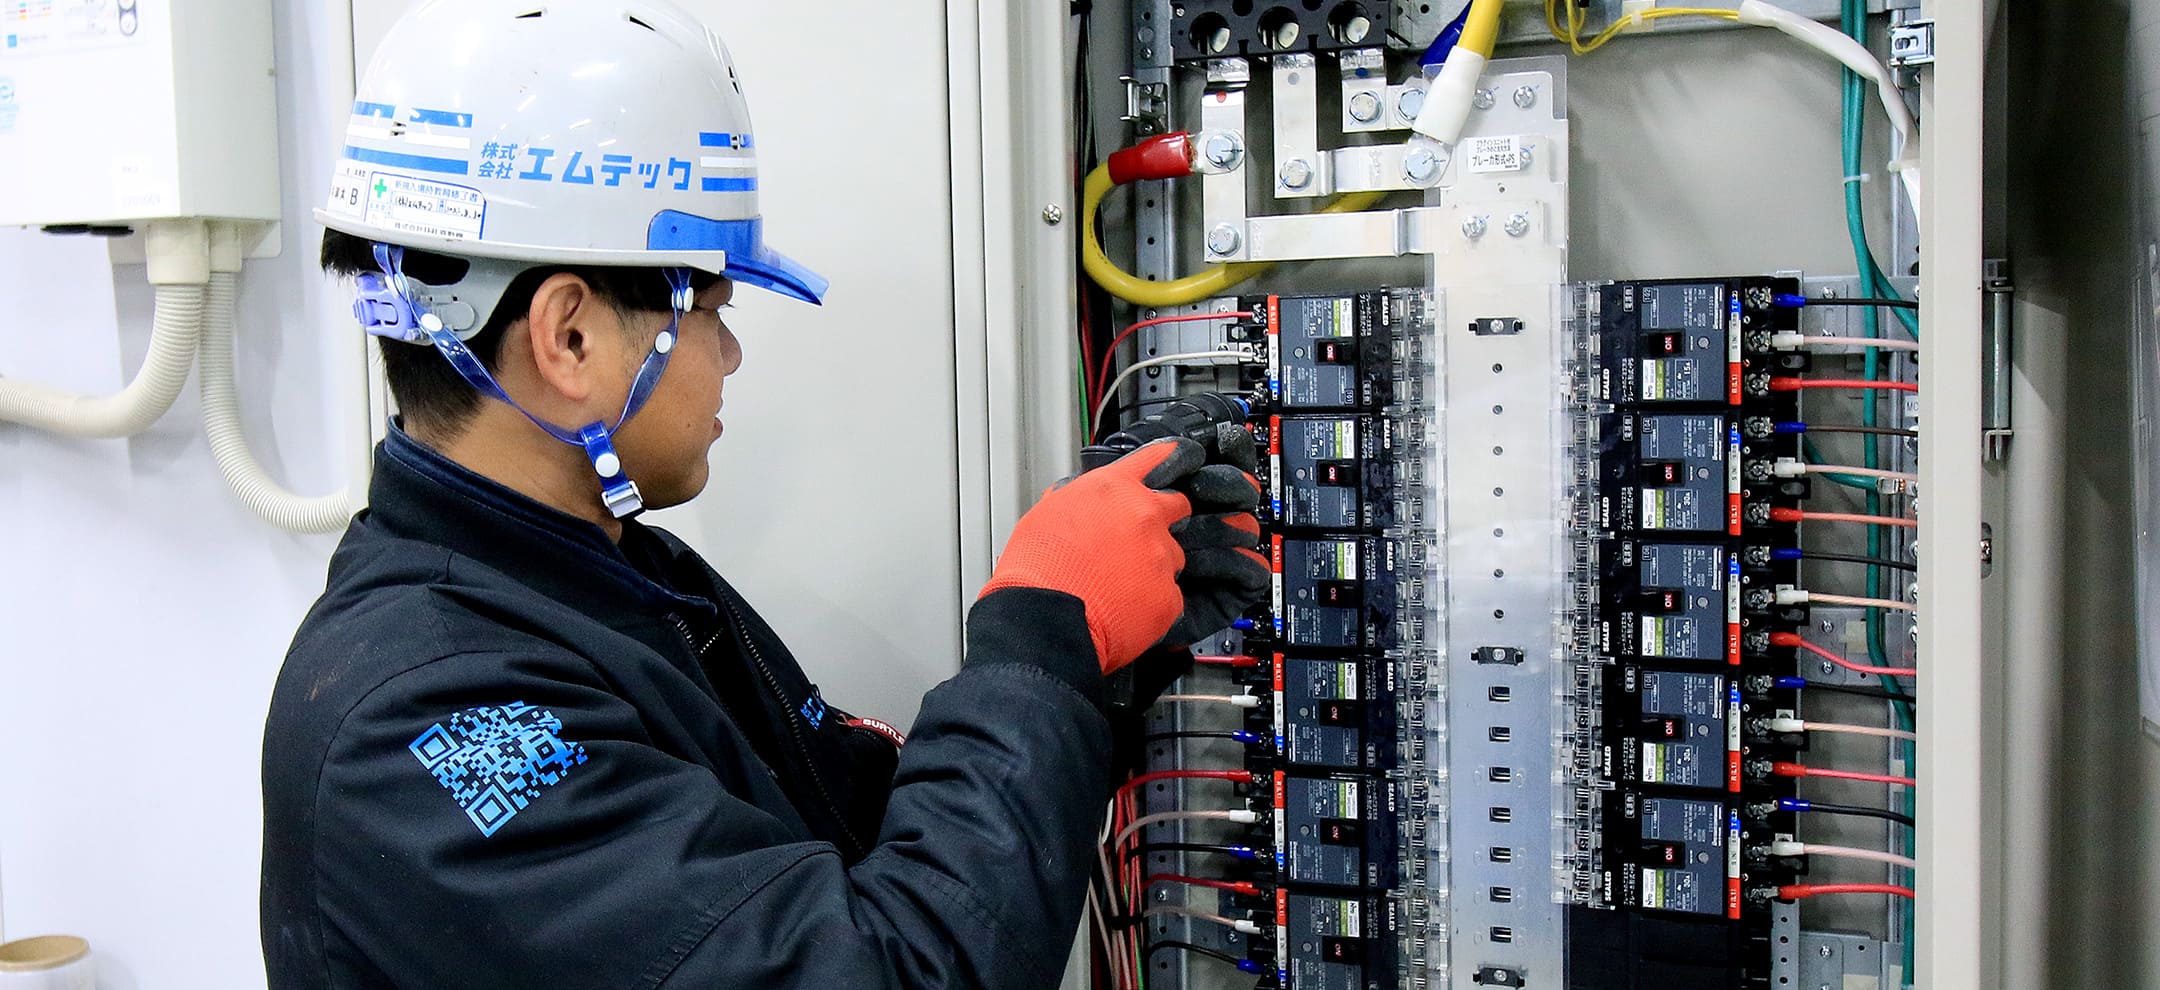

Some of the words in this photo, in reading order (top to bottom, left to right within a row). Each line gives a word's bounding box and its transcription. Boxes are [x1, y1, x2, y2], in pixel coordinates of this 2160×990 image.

[481, 142, 518, 160] 株式
[478, 161, 514, 180] 会社
[519, 147, 691, 191] エムテック
[1665, 337, 1672, 350] ON
[1328, 345, 1333, 358] ON
[1329, 467, 1335, 480] ON
[1665, 466, 1672, 479] ON
[1331, 588, 1336, 600] ON
[1665, 594, 1672, 607] ON
[1331, 706, 1337, 719] ON
[862, 718, 905, 746] BURTLE
[1666, 721, 1672, 735] ON
[1332, 826, 1338, 838] ON
[1666, 847, 1672, 860] ON
[1335, 944, 1340, 956] ON
